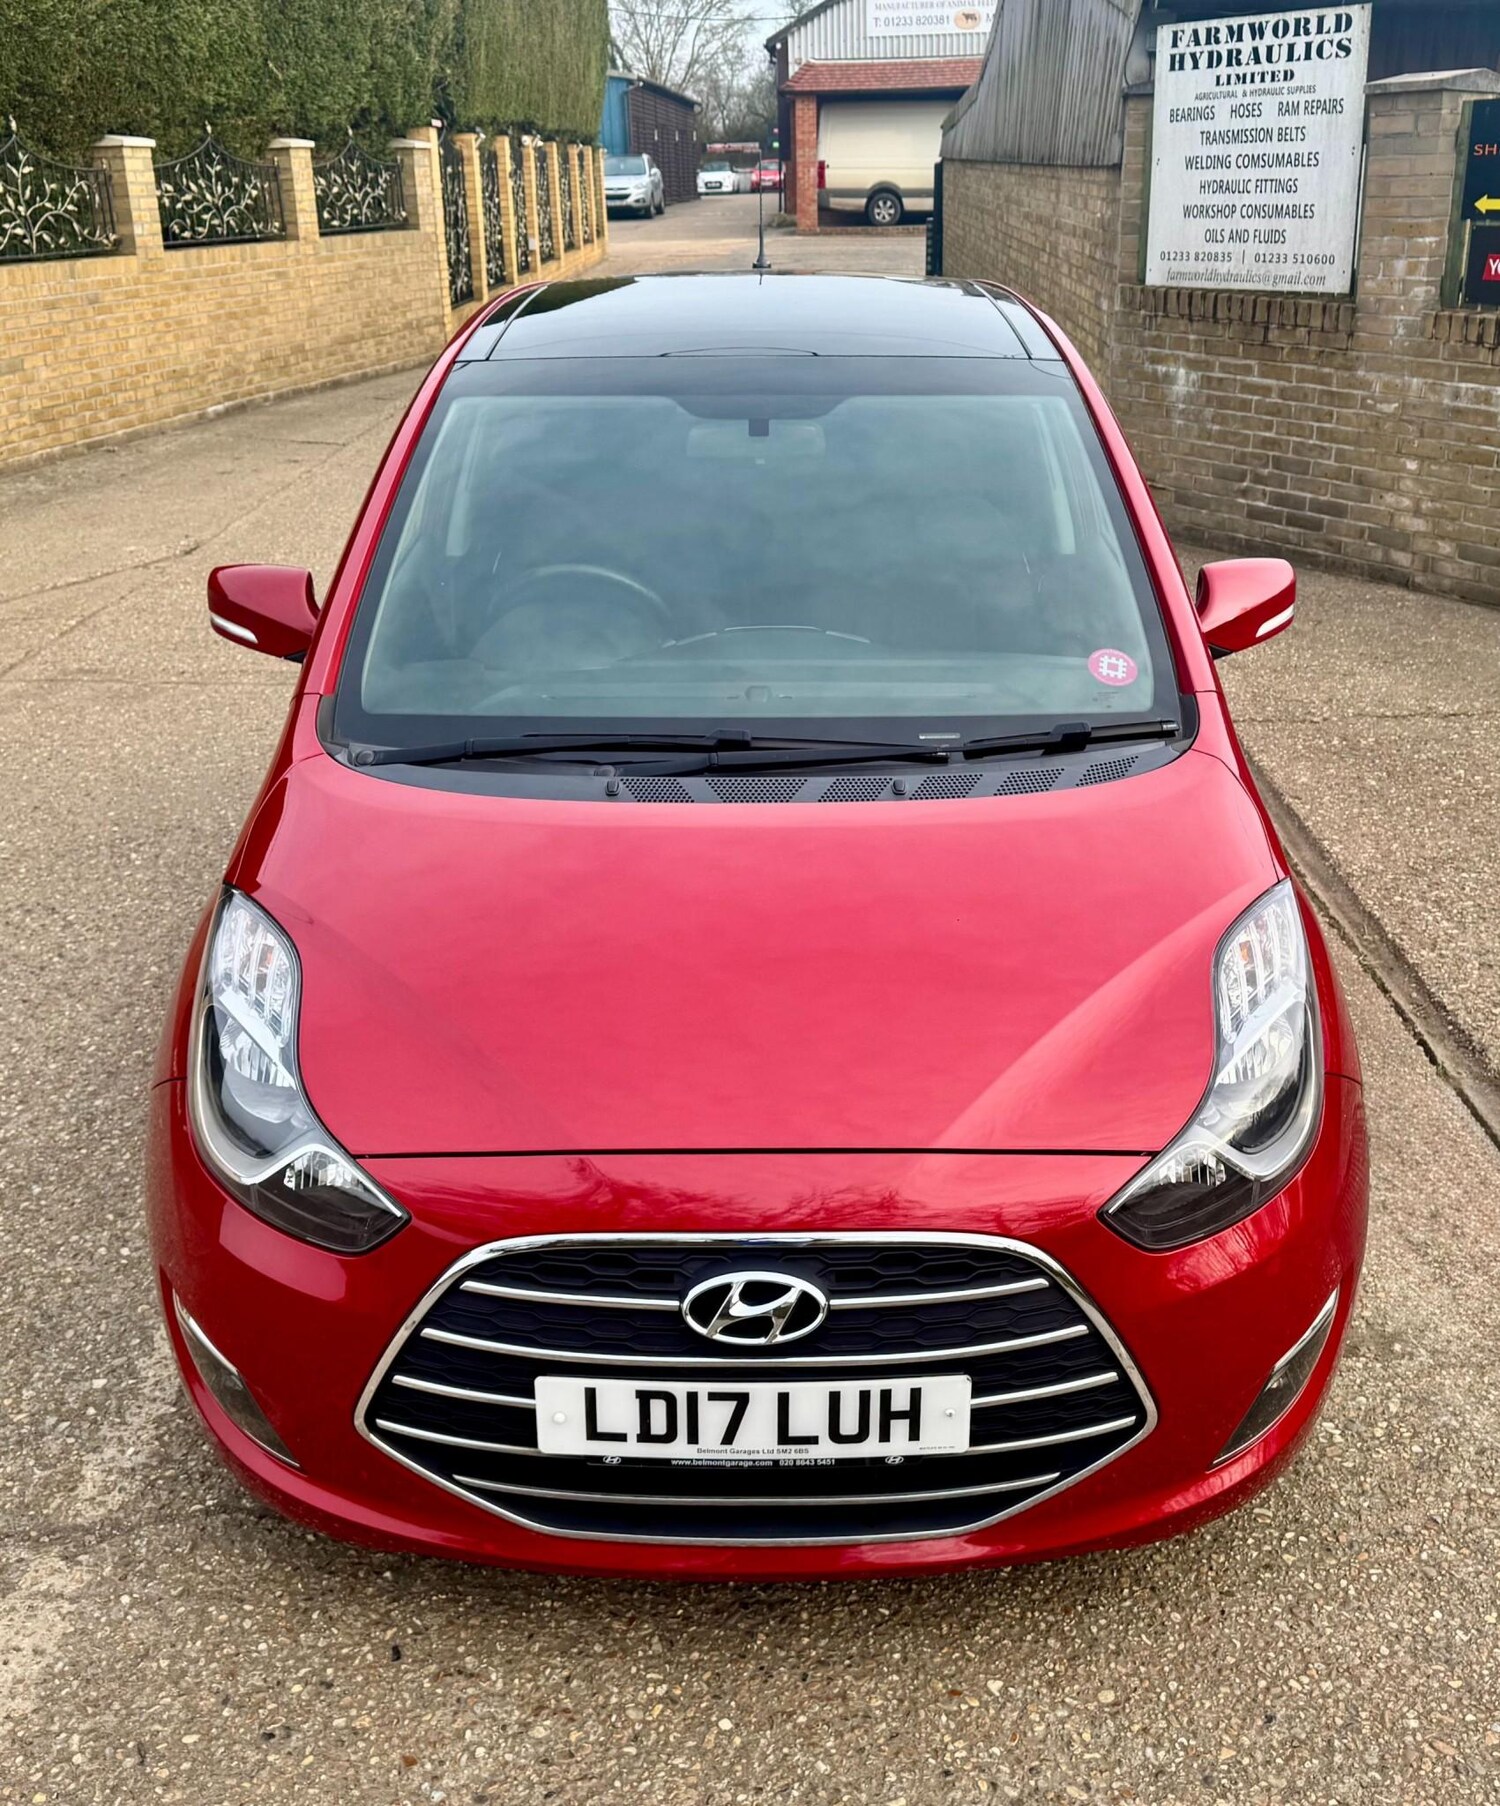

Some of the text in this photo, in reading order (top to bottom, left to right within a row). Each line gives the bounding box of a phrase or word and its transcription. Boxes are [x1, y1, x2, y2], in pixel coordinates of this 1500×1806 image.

[884, 16, 913, 27] 01233
[916, 15, 951, 26] 820381
[1171, 12, 1353, 48] FARMWORLD
[1168, 38, 1352, 72] HYDRAULICS
[1215, 69, 1295, 87] LIMITED
[1194, 85, 1317, 101] AGRICULTURAL & HYDRAULIC SUPPLIES
[1169, 98, 1345, 123] BEARINGS HOSES RAM REPAIRS
[1200, 126, 1306, 146] TRANSMISSION BELTS
[1473, 143, 1500, 156] SH
[1185, 152, 1320, 170] WELDING COMSUMABLES
[1199, 178, 1298, 194] HYDRAULIC FITTINGS
[1183, 203, 1315, 219] WORKSHOP CONSUMABLES
[1204, 228, 1287, 244] OILS AND FLUIDS
[1160, 251, 1335, 265] 01233 820835 01233 510600
[1166, 267, 1326, 287] farmworldhydraulics@gmail.com
[584, 1386, 922, 1446] LD17 LUH
[697, 1447, 728, 1455] Belmont
[729, 1447, 760, 1456] Garages
[762, 1447, 775, 1455] Ltd
[671, 1458, 773, 1467] www.belmontgarage.com
[817, 1458, 836, 1466] 5451
